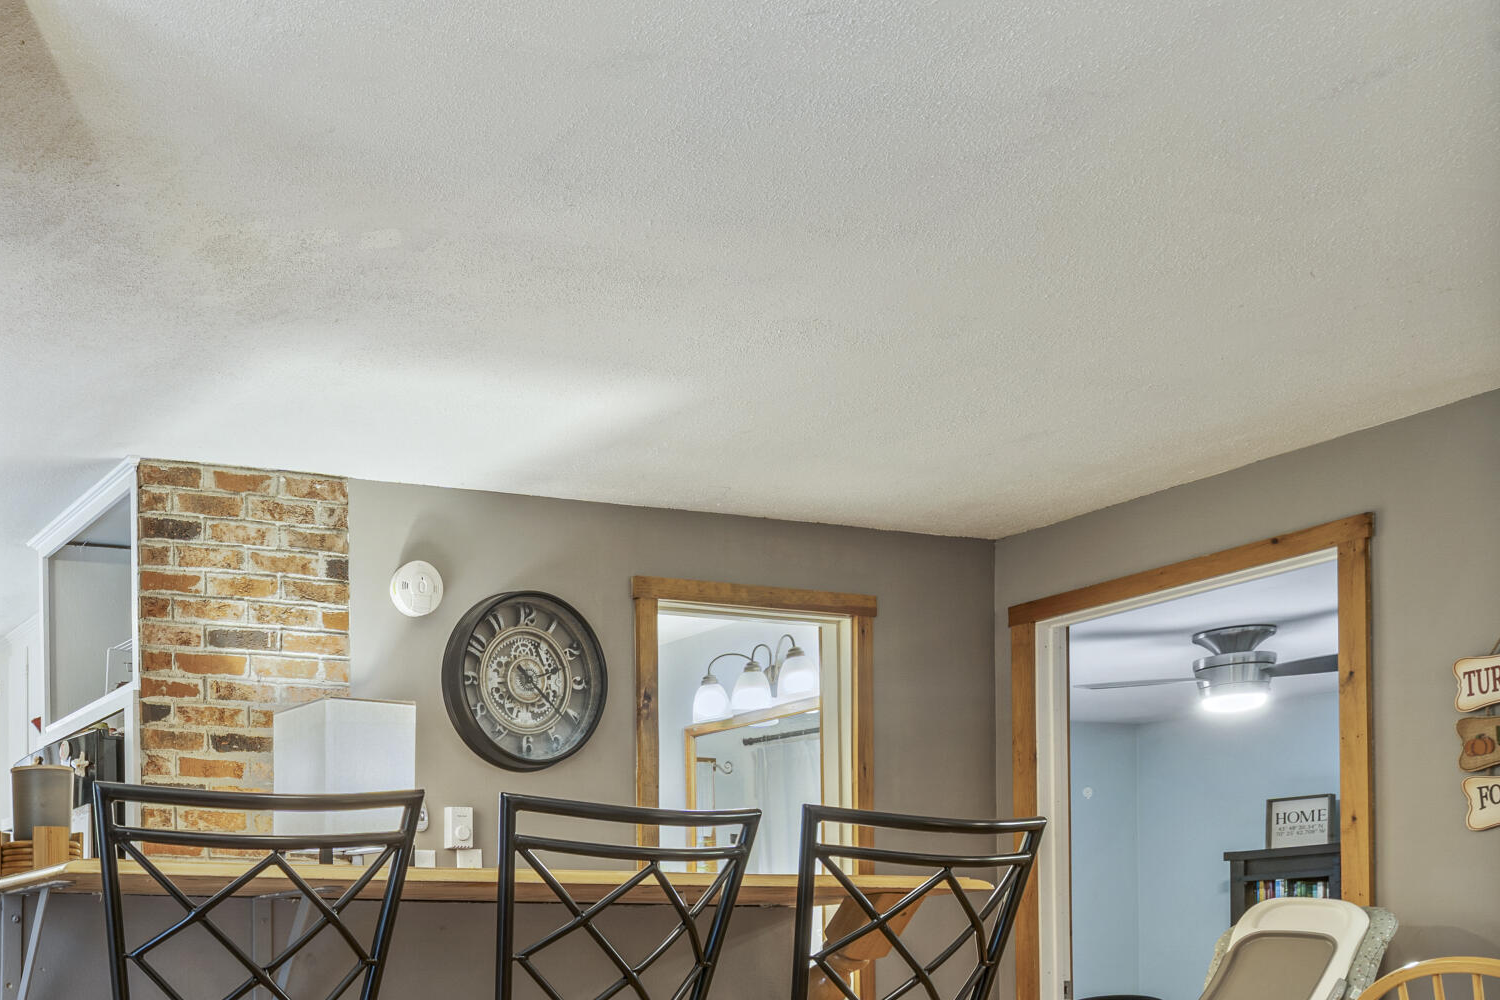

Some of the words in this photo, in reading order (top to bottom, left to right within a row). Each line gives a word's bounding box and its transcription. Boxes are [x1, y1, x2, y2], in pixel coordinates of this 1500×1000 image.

[520, 604, 537, 626] 12
[563, 641, 582, 660] 2
[522, 736, 534, 752] 6
[1276, 808, 1328, 825] HOME
